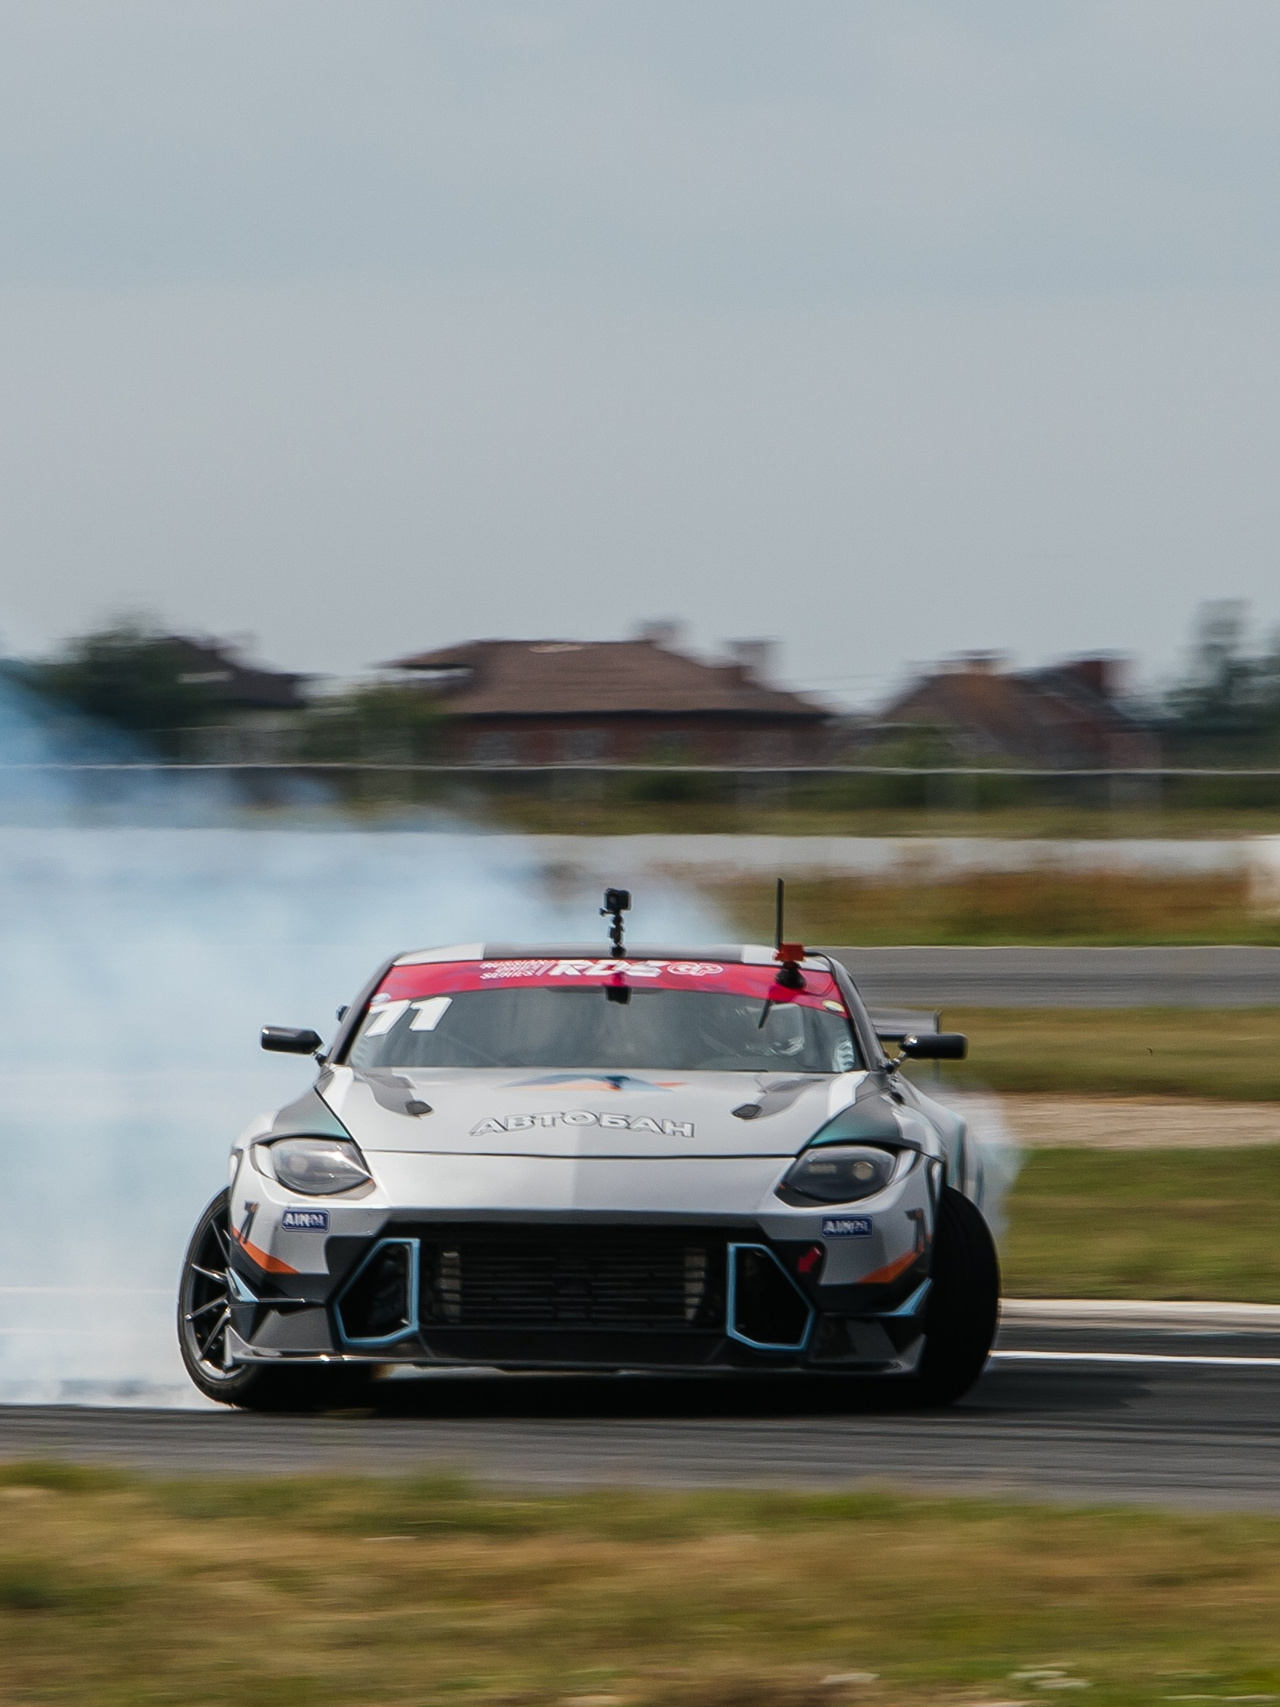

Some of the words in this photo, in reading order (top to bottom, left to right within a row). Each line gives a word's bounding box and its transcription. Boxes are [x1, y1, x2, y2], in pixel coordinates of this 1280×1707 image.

[548, 959, 670, 977] RDS
[364, 996, 453, 1037] 11
[469, 1109, 694, 1138] АВТОБАН
